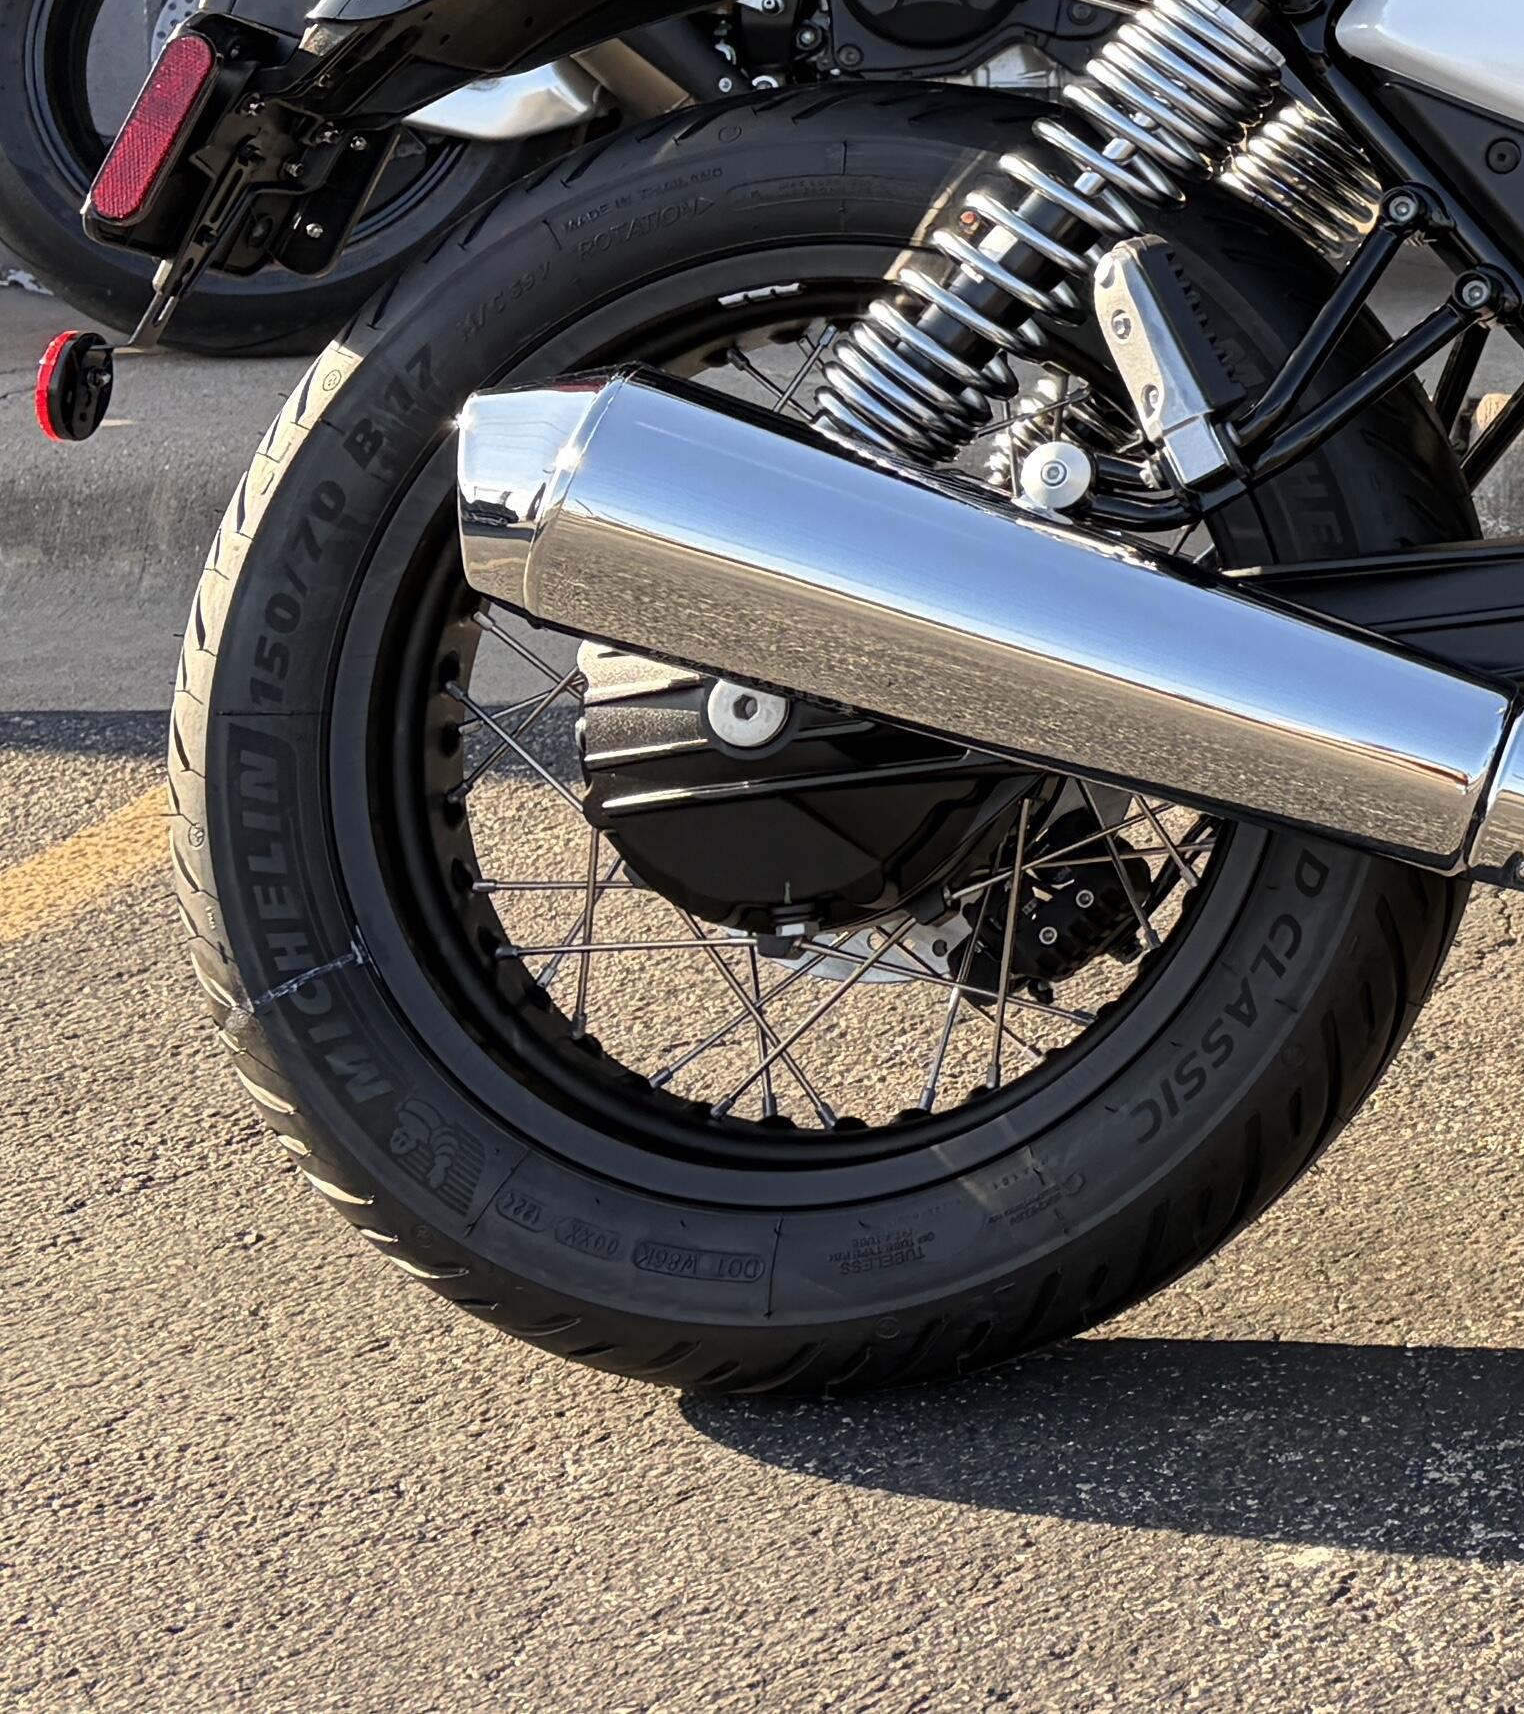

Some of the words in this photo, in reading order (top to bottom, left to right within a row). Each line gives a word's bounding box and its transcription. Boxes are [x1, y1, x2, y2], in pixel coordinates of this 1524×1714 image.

[576, 202, 697, 259] ROTATION
[384, 345, 435, 415] 17
[342, 416, 386, 469] B
[250, 480, 347, 706] 150/70
[239, 750, 392, 1106] MICHELIN
[1129, 912, 1303, 1146] CLASSIC
[713, 1258, 759, 1280] DOT
[839, 1246, 926, 1276] TUBELESS
